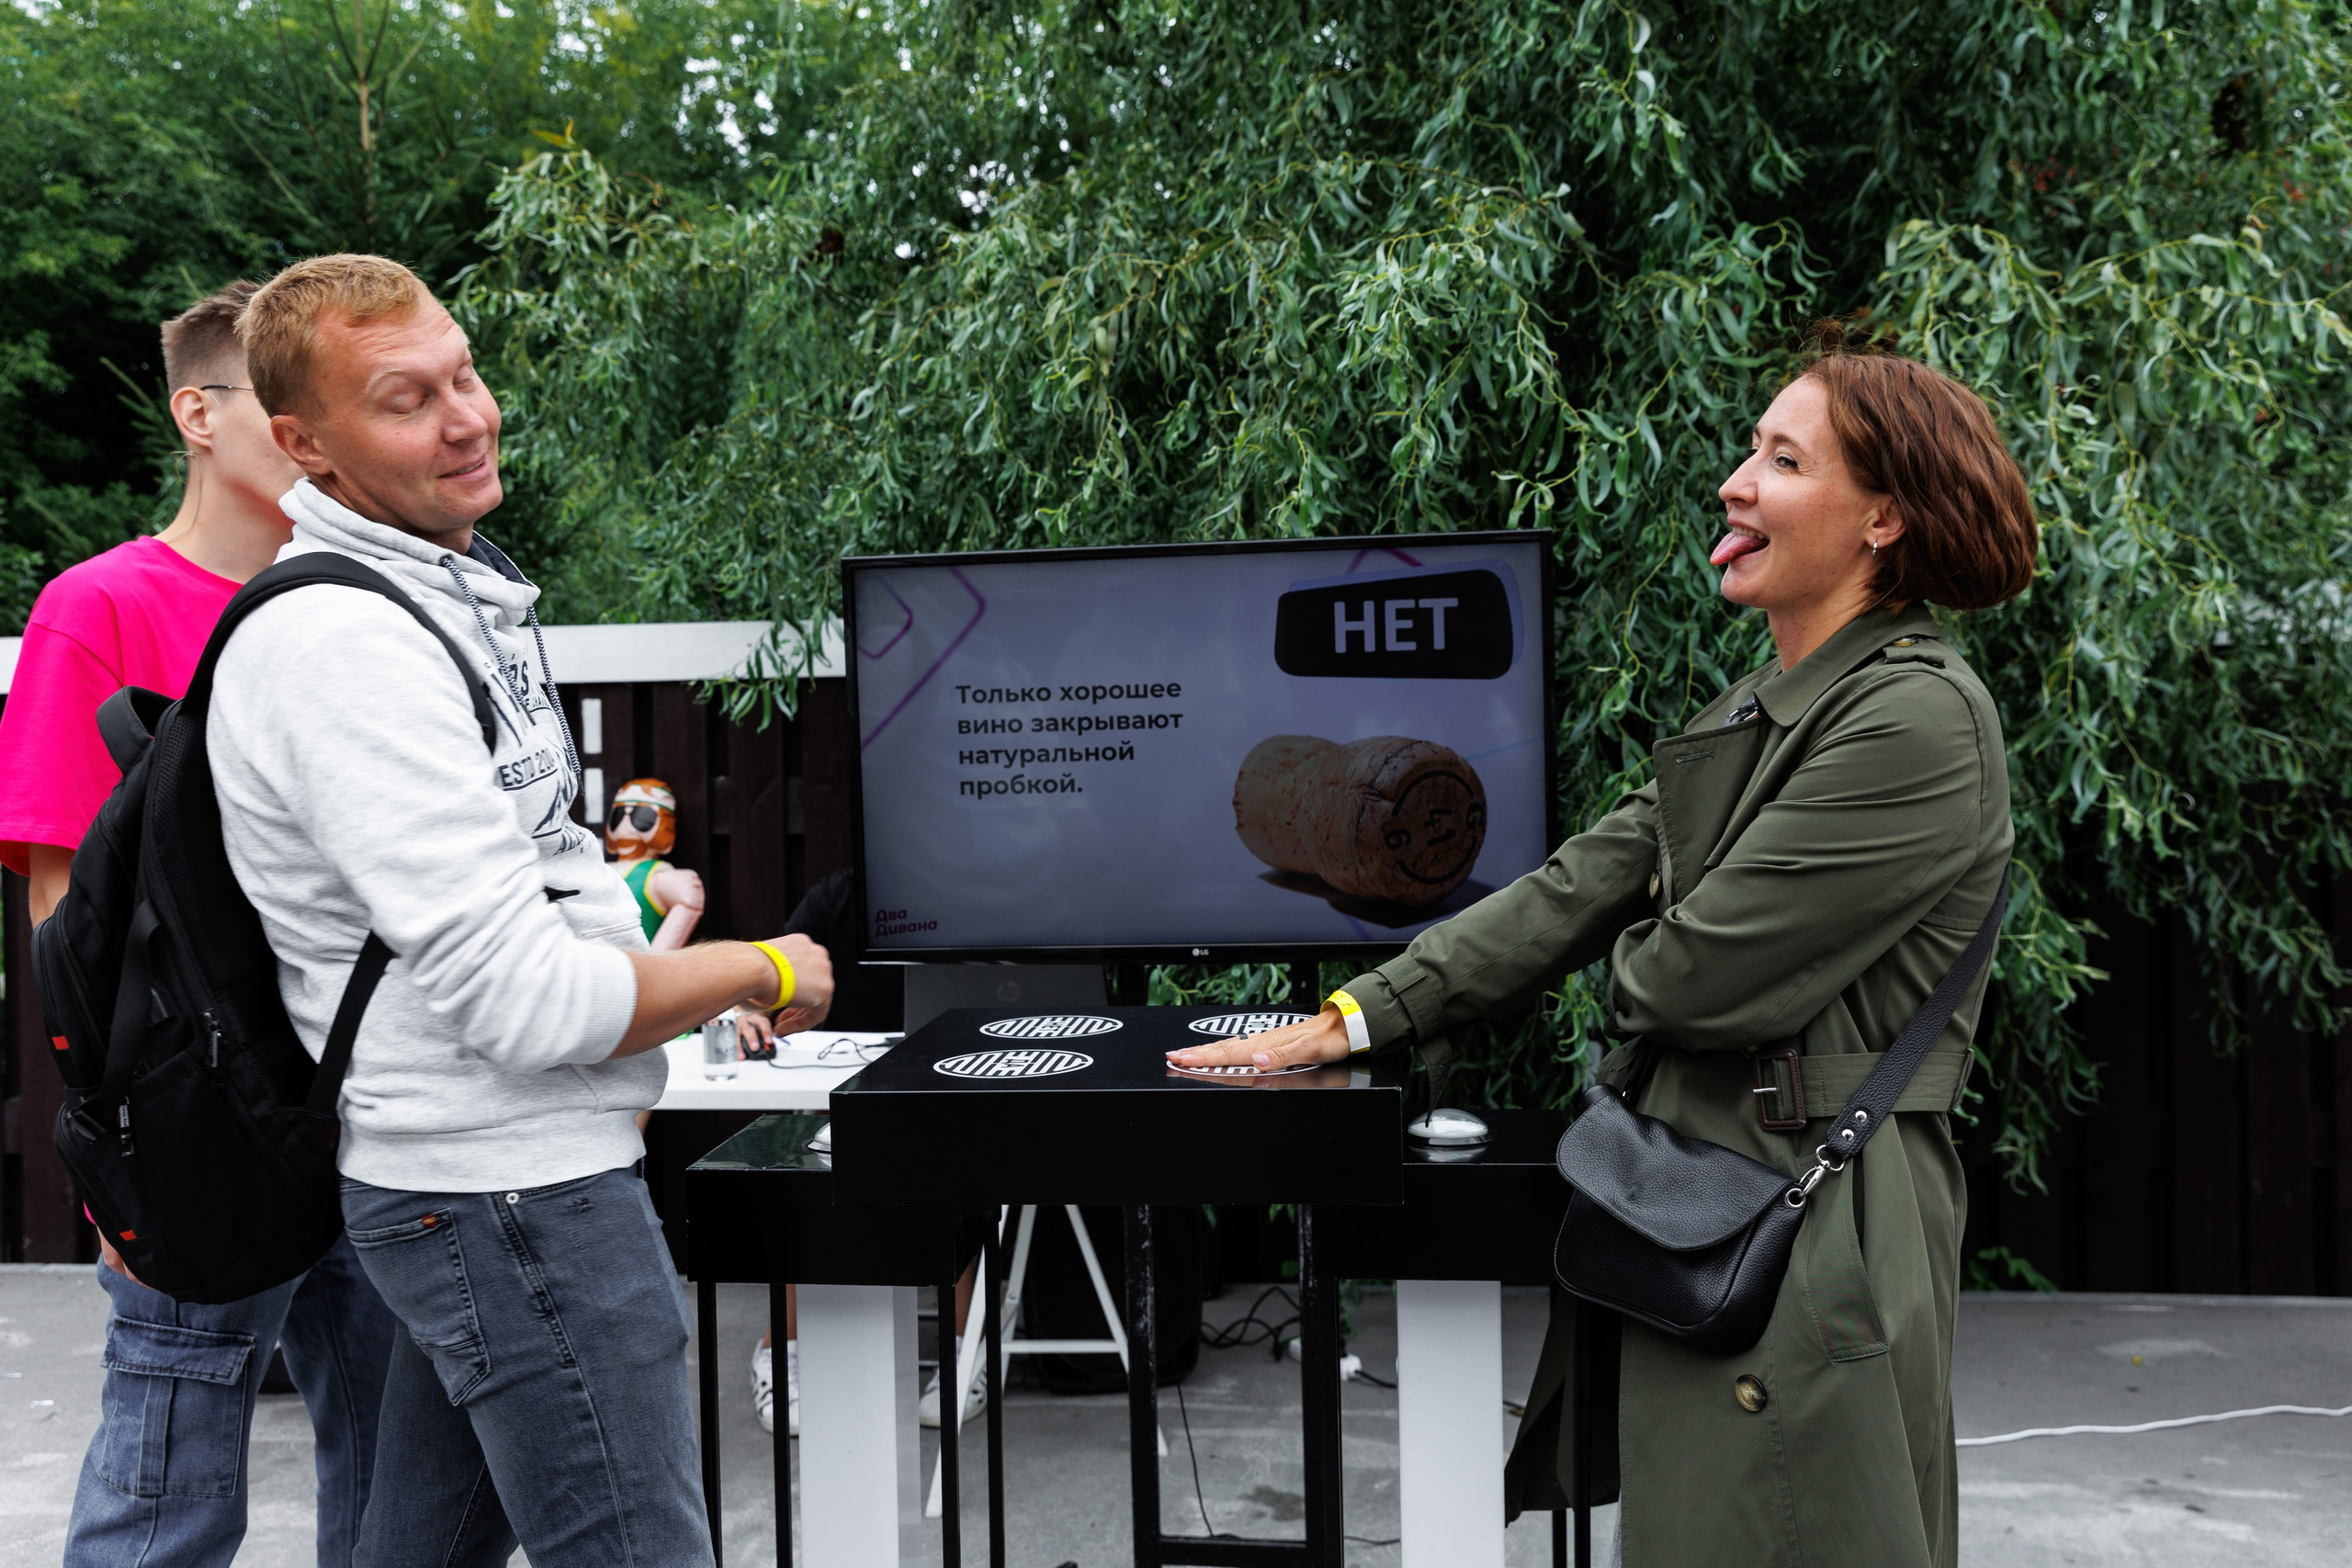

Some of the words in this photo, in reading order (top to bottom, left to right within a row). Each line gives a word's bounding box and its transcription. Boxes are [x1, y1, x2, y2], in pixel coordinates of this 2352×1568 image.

[1334, 597, 1459, 653] НЕТ
[956, 684, 1052, 705] Только
[1059, 682, 1182, 705] хорошее
[957, 717, 1023, 735] вино
[1031, 713, 1183, 736] закрывают
[958, 739, 1136, 769] натуральной
[959, 773, 1083, 800] пробкой.
[1424, 808, 1456, 846] 41
[1465, 801, 1486, 830] G
[875, 908, 908, 925] Два
[875, 920, 938, 939] Дивана
